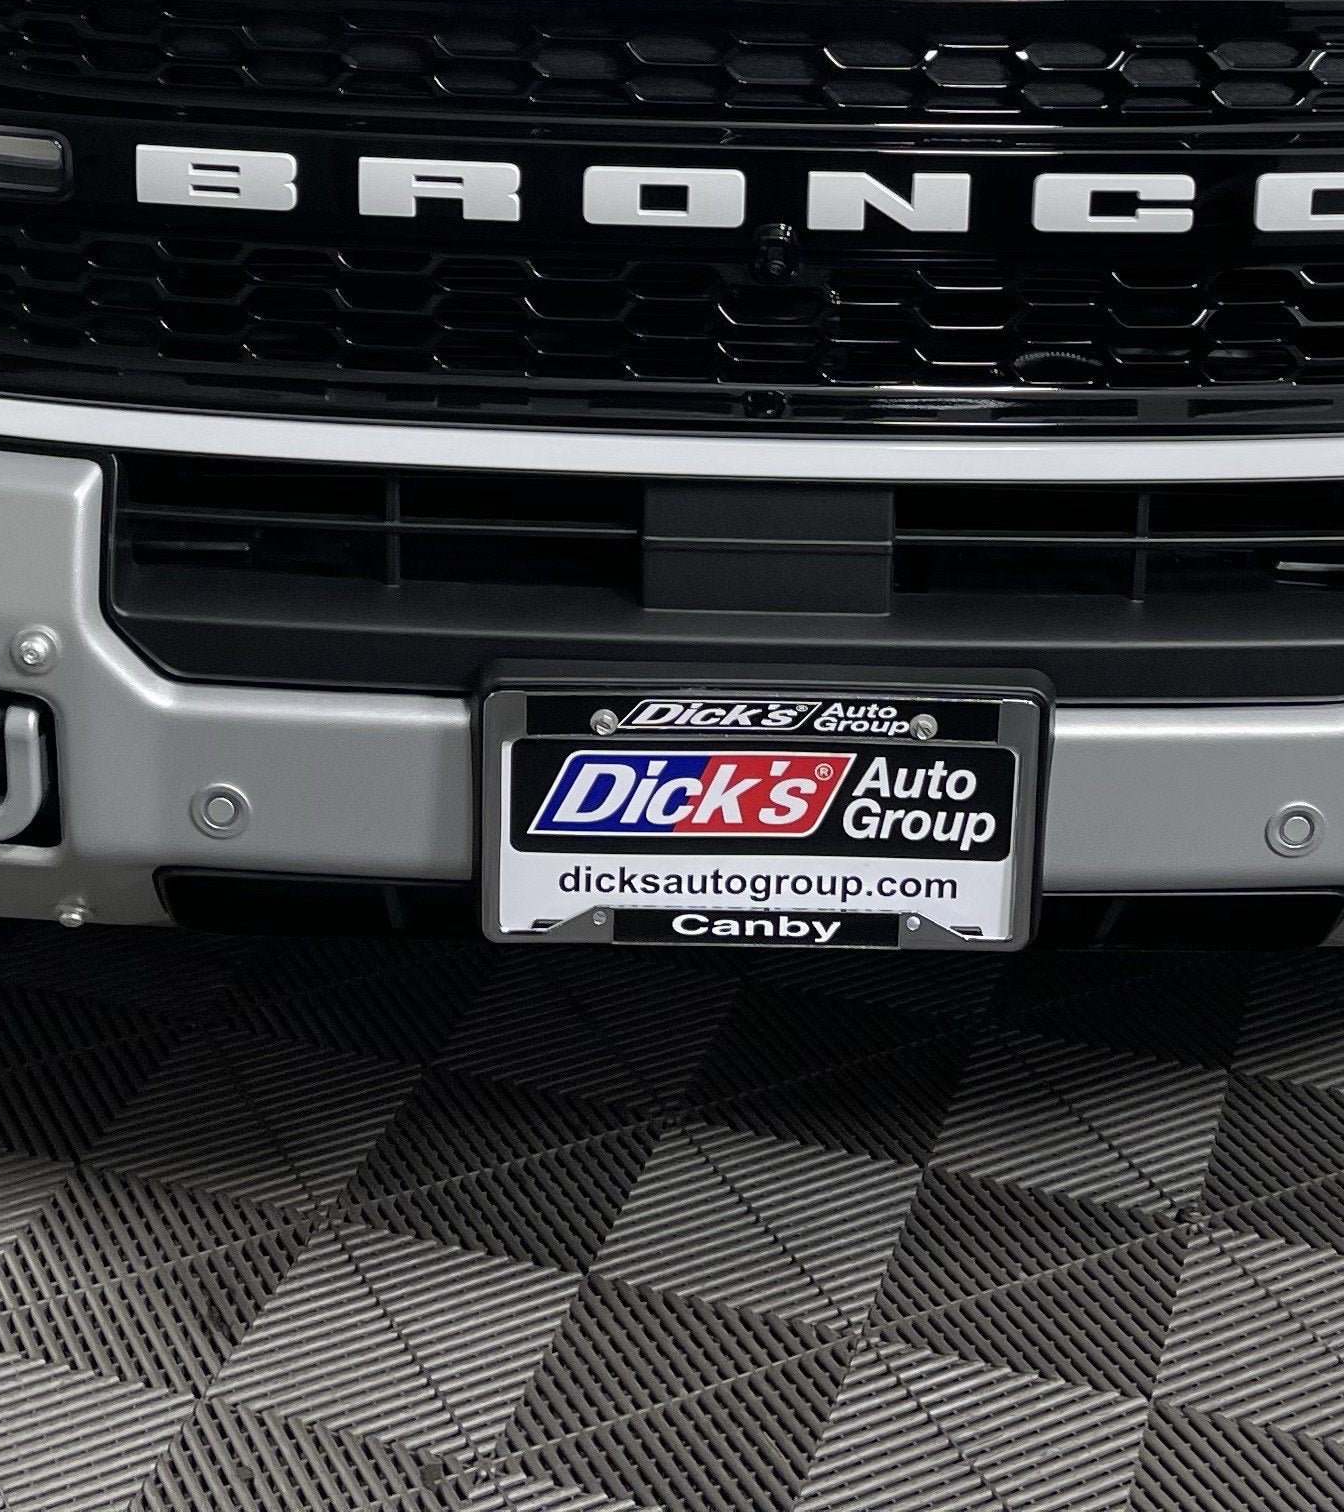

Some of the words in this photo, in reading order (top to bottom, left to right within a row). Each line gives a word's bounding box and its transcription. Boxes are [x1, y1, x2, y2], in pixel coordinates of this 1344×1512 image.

[631, 702, 798, 726] Dick's
[813, 717, 911, 736] Group
[821, 702, 898, 719] Auto
[552, 760, 818, 825] Dick's
[851, 756, 977, 801] Auto
[842, 797, 996, 851] Group
[558, 865, 957, 903] dicksautogroup.com
[671, 913, 842, 943] Canby
